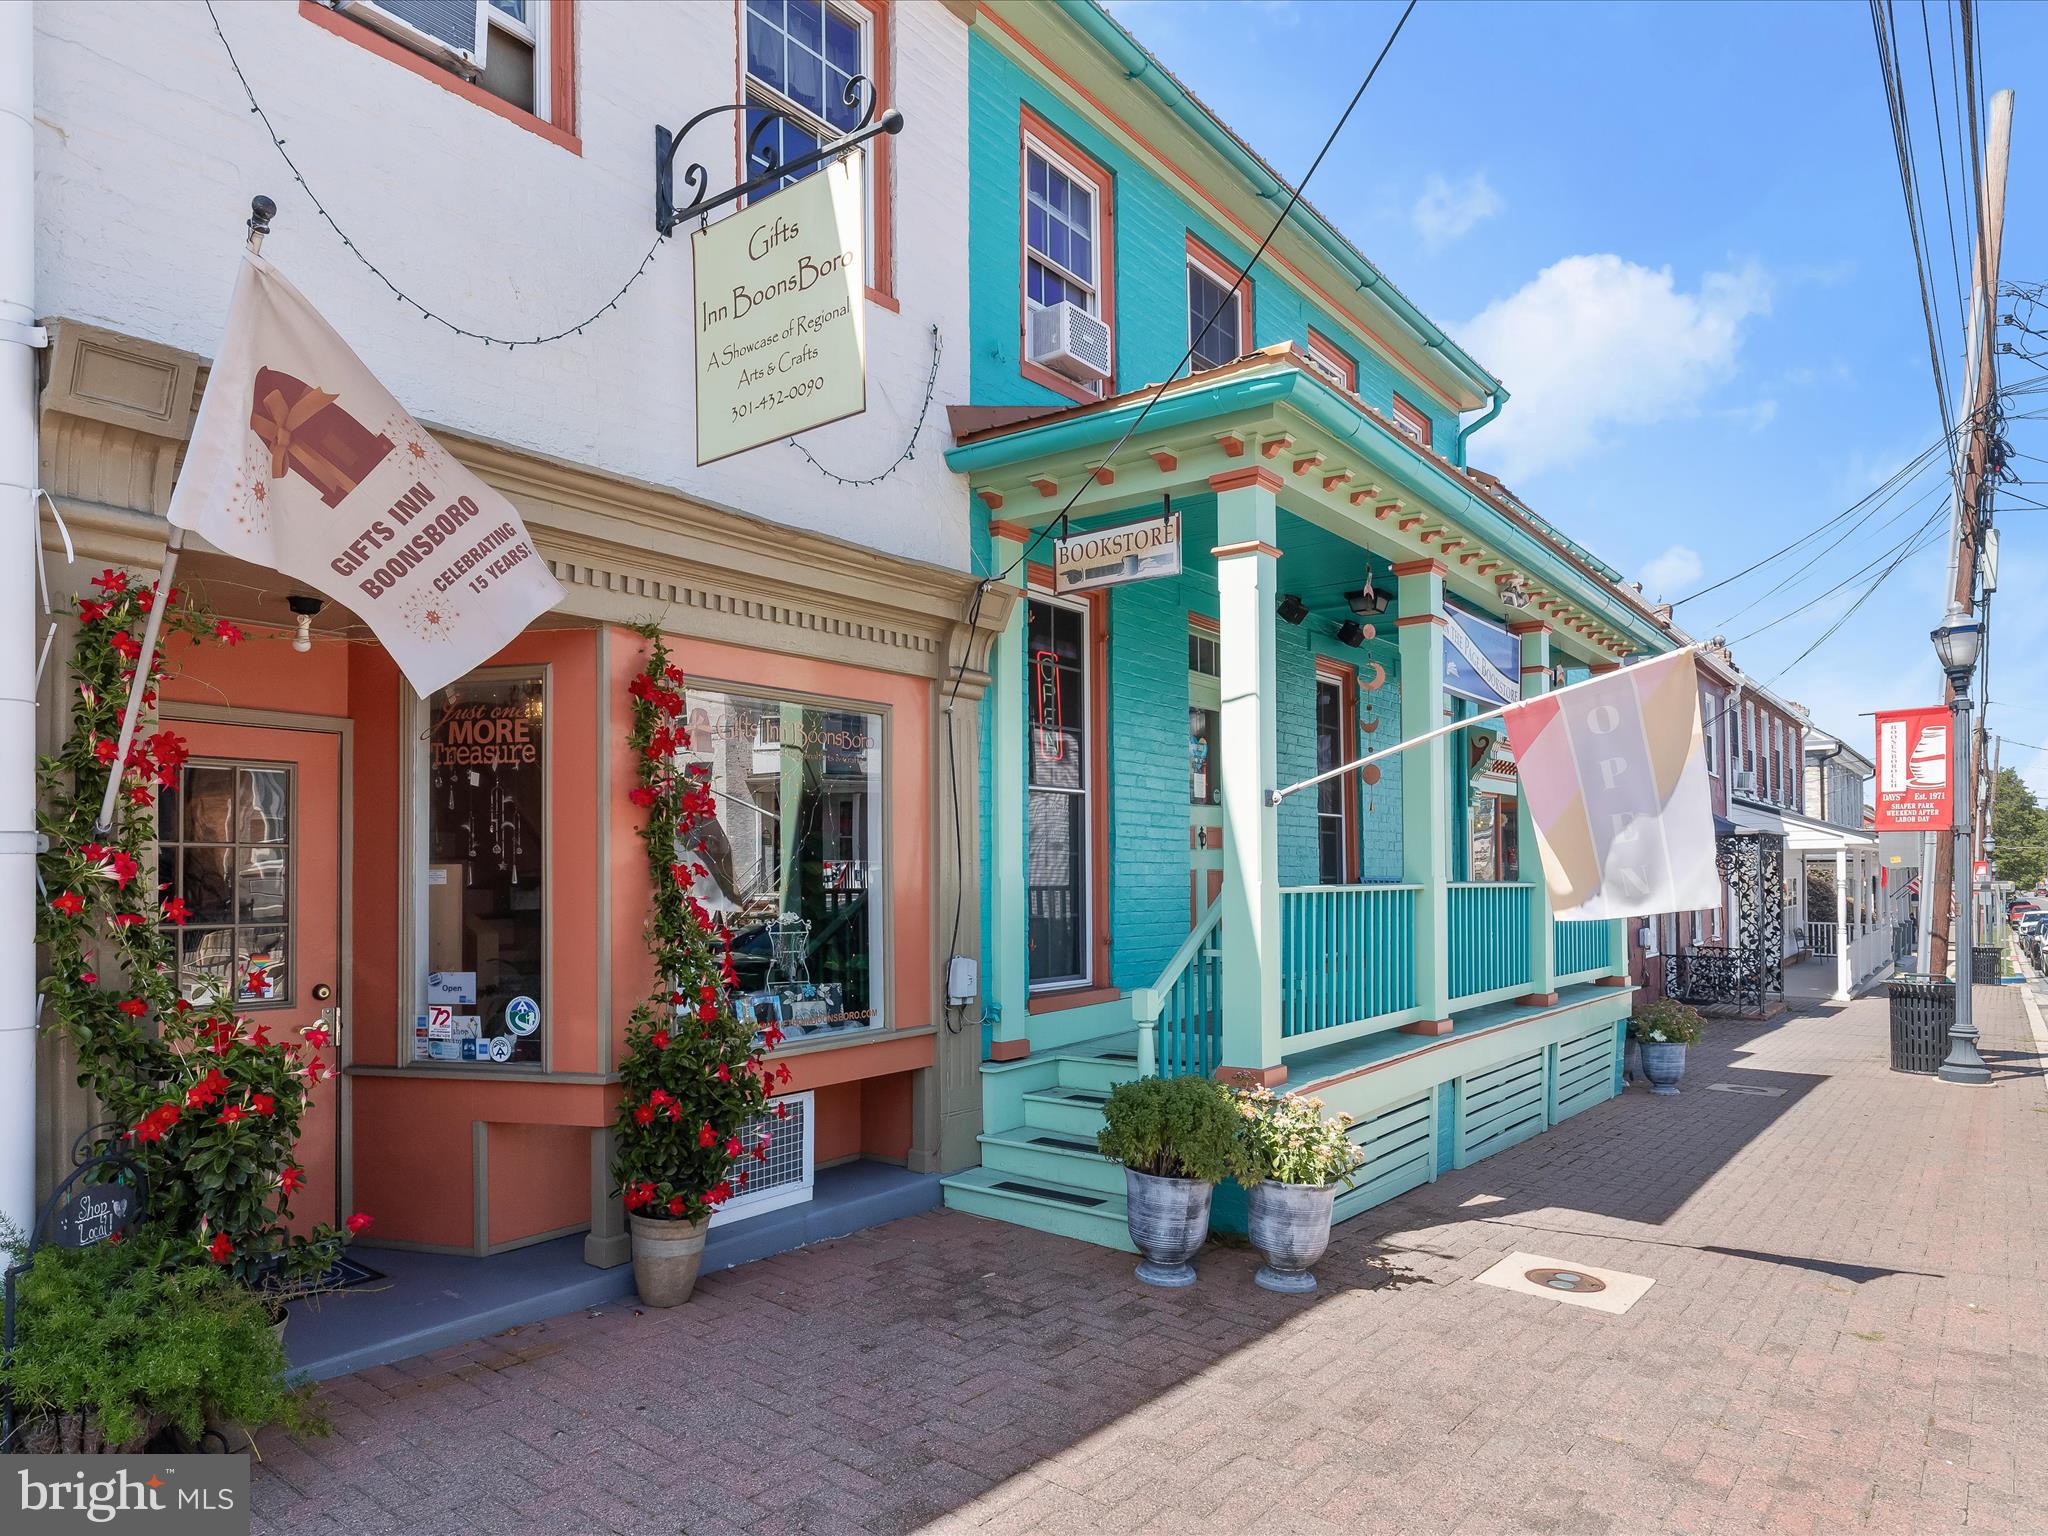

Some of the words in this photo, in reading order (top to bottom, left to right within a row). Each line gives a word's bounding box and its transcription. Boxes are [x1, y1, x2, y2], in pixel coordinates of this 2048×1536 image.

[748, 216, 800, 261] Gifts
[702, 301, 728, 332] Inn
[732, 251, 854, 320] BoonsBoro
[707, 351, 720, 372] A
[721, 332, 780, 366] Showcase
[781, 319, 796, 341] of
[797, 295, 851, 337] Regional
[737, 368, 765, 390] Arts
[767, 362, 776, 377] &
[777, 344, 819, 373] Crafts
[731, 376, 825, 423] 301-432-0090
[330, 520, 396, 577] GIFTS
[387, 481, 436, 526] INN
[358, 495, 480, 600] BOONSBORO
[1059, 524, 1174, 565] BOOKSTORE
[432, 522, 518, 592] CELEBRATING
[468, 575, 489, 595] 15
[485, 541, 533, 580] YEARS!
[420, 692, 486, 741] Just
[448, 719, 530, 745] MORE
[716, 713, 758, 742] Gifts
[430, 741, 536, 766] Treasure
[1587, 705, 1650, 897] OPEN
[1882, 793, 1901, 801] DAYS
[442, 984, 463, 993] Open
[78, 1195, 108, 1222] Shop
